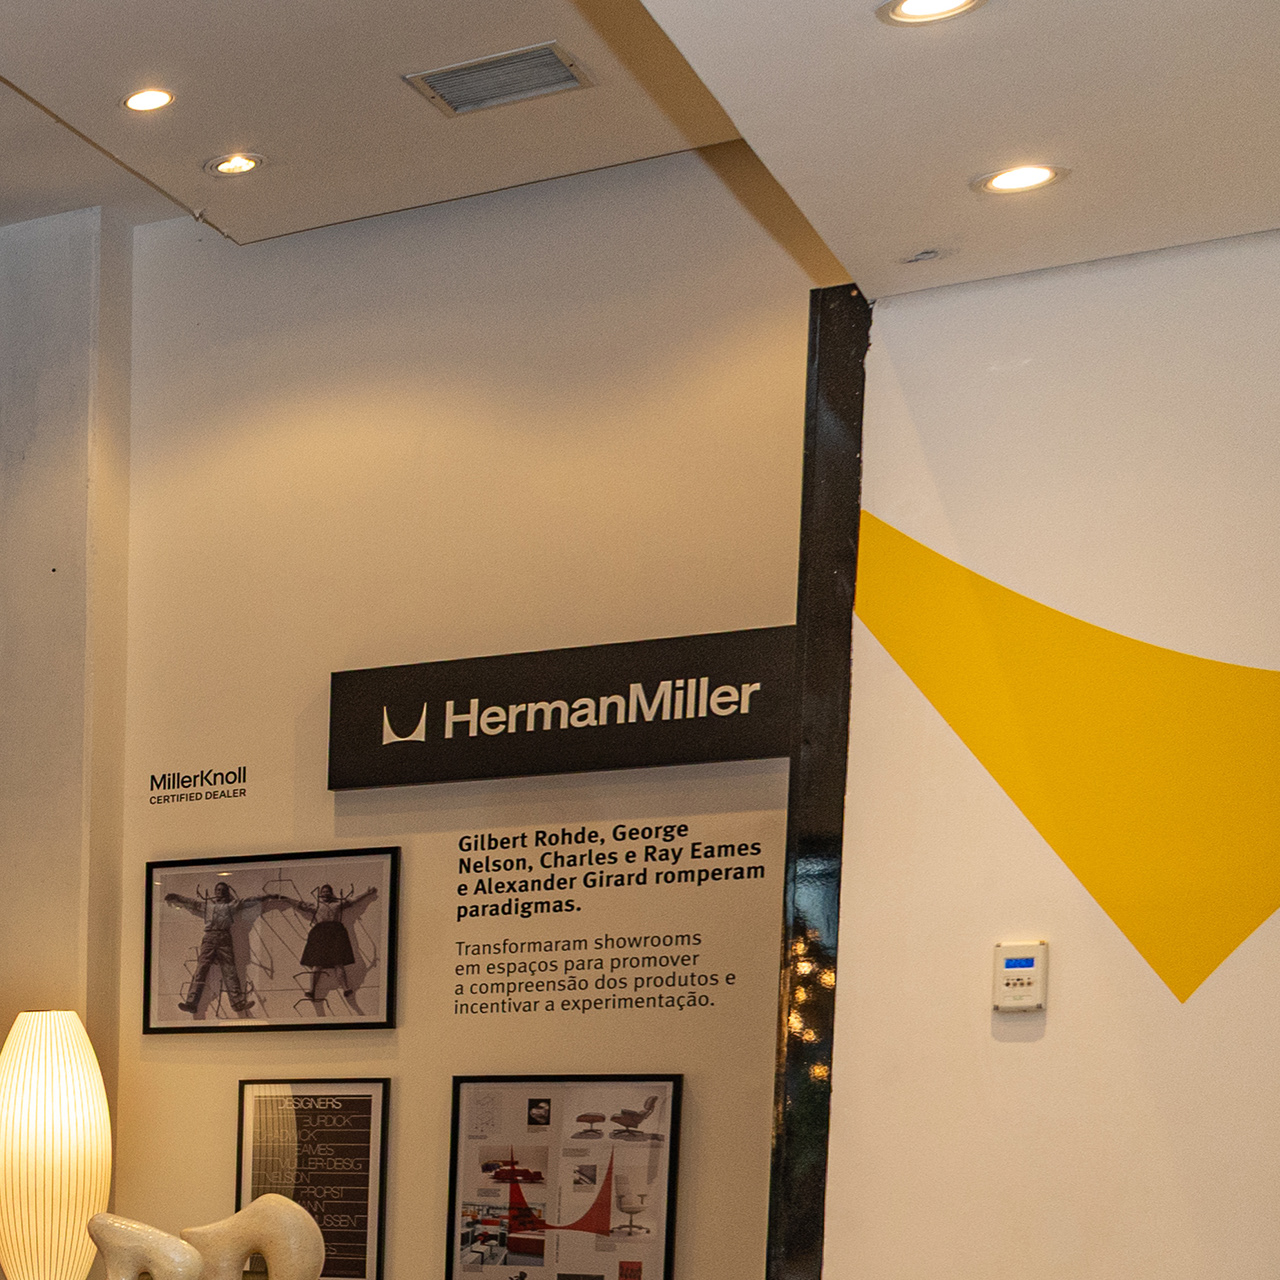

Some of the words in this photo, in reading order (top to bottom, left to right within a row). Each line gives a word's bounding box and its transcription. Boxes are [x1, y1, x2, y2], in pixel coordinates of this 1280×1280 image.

[445, 677, 760, 738] HermanMiller
[150, 766, 246, 791] MillerKnoll
[150, 792, 202, 805] CERTIFIED
[205, 788, 246, 800] DEALER
[459, 832, 527, 852] Gilbert
[535, 827, 605, 847] Rohde,
[613, 824, 688, 842] George
[459, 856, 533, 874] Nelson,
[540, 849, 617, 868] Charles
[625, 851, 636, 863] e
[644, 845, 683, 865] Ray
[691, 842, 761, 859] Eames
[457, 884, 467, 896] e
[474, 873, 577, 895] Alexander
[583, 868, 647, 888] Girard
[656, 865, 764, 886] romperam
[457, 898, 581, 922] paradigmas.
[455, 938, 587, 956] Transformaram
[594, 933, 701, 950] showrooms
[455, 964, 480, 976] em
[487, 960, 558, 977] espaços
[564, 958, 603, 975] para
[610, 954, 700, 973] promover
[455, 984, 463, 995] a
[470, 975, 588, 997] compreensão
[595, 974, 627, 990] dos
[634, 971, 719, 992] produtos
[725, 973, 736, 985] e
[455, 998, 540, 1014] incentivar
[545, 1000, 554, 1011] a
[561, 991, 714, 1014] experimentação.
[279, 1097, 342, 1109] DESIGNERS
